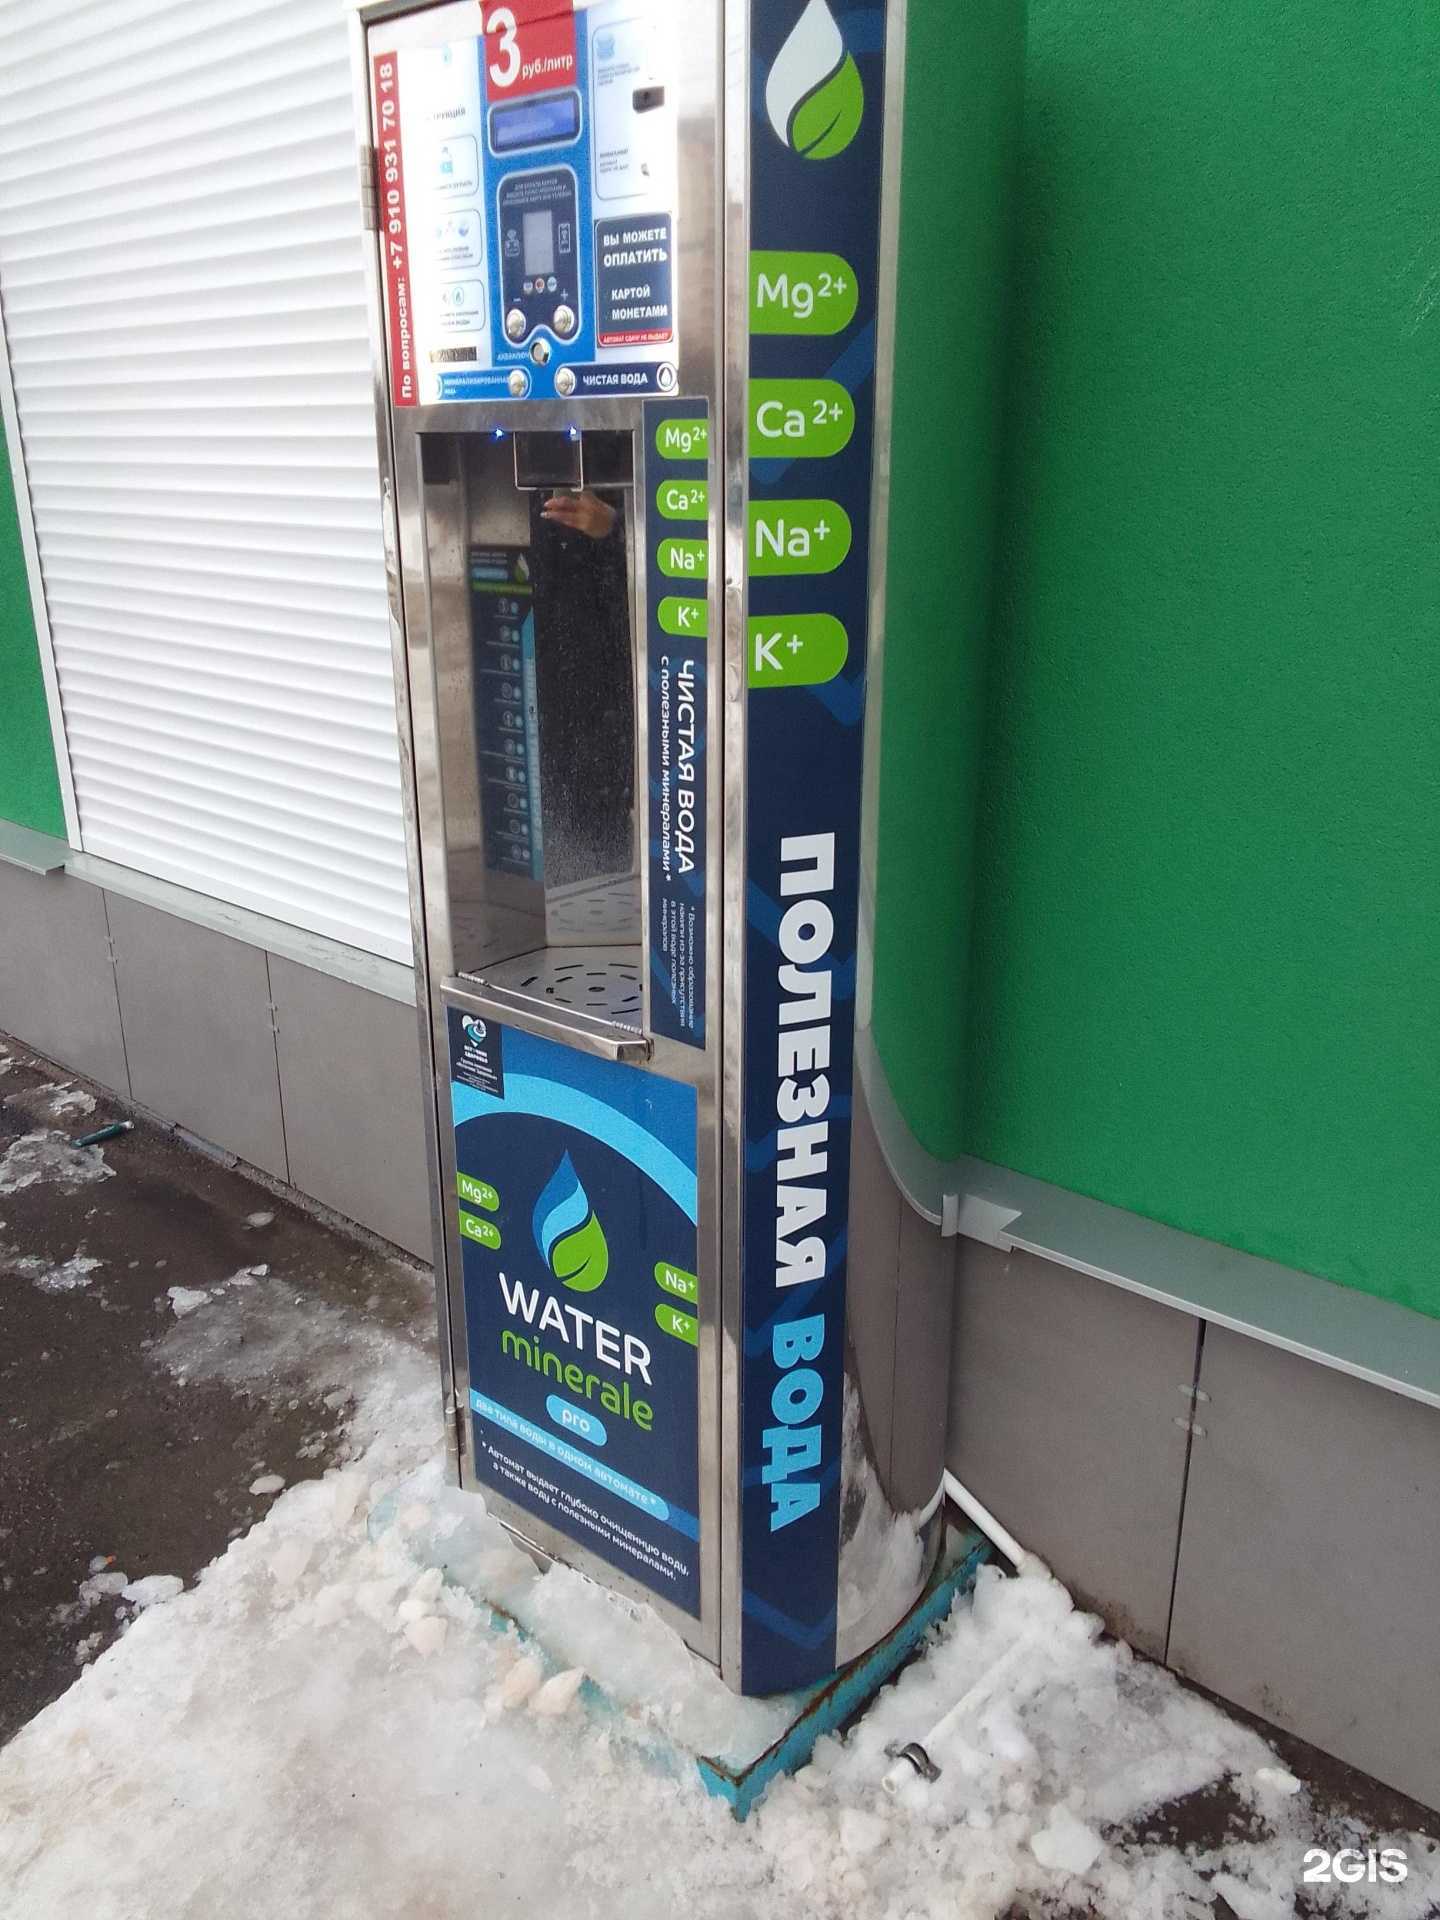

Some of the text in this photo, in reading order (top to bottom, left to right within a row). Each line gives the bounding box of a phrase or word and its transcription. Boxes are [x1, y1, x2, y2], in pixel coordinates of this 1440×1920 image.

[487, 7, 521, 88] 3
[522, 54, 573, 80] руб./литр
[379, 62, 412, 399] По вопросам: +7 910 931 70 18
[603, 227, 667, 247] ВЫ МОЖЕТЕ
[603, 248, 668, 268] ОПЛАТИТЬ
[611, 284, 651, 301] КАРТОЙ
[756, 272, 847, 319] Mg2+
[612, 304, 668, 320] МОНЕТАМИ
[583, 372, 648, 386] ЧИСТАЯ ВОДА
[665, 427, 708, 453] Mg2+
[755, 518, 830, 558] Na+
[670, 547, 705, 570] Na+
[677, 606, 699, 628] K+
[755, 632, 803, 672] K+
[660, 656, 671, 872] с полезными минералами
[675, 659, 695, 874] ЧИСТАЯ ВОДА
[462, 1179, 493, 1204] Mg2+
[761, 832, 836, 1532] ПОЛЕЗНАЯ ВОДА
[465, 1219, 494, 1238] Ca2+
[665, 1270, 696, 1293] Na+
[499, 1271, 653, 1386] WATER
[672, 1314, 690, 1334] K+
[501, 1329, 654, 1431] minerale
[562, 1408, 591, 1434] pro
[520, 1423, 547, 1445] воды
[557, 1445, 593, 1474] одном
[593, 1465, 648, 1503] автомате
[488, 1445, 689, 1577] Автомат выдает глубоко очищенную воду,
[492, 1461, 677, 1581] а также воду с полезными минералами.
